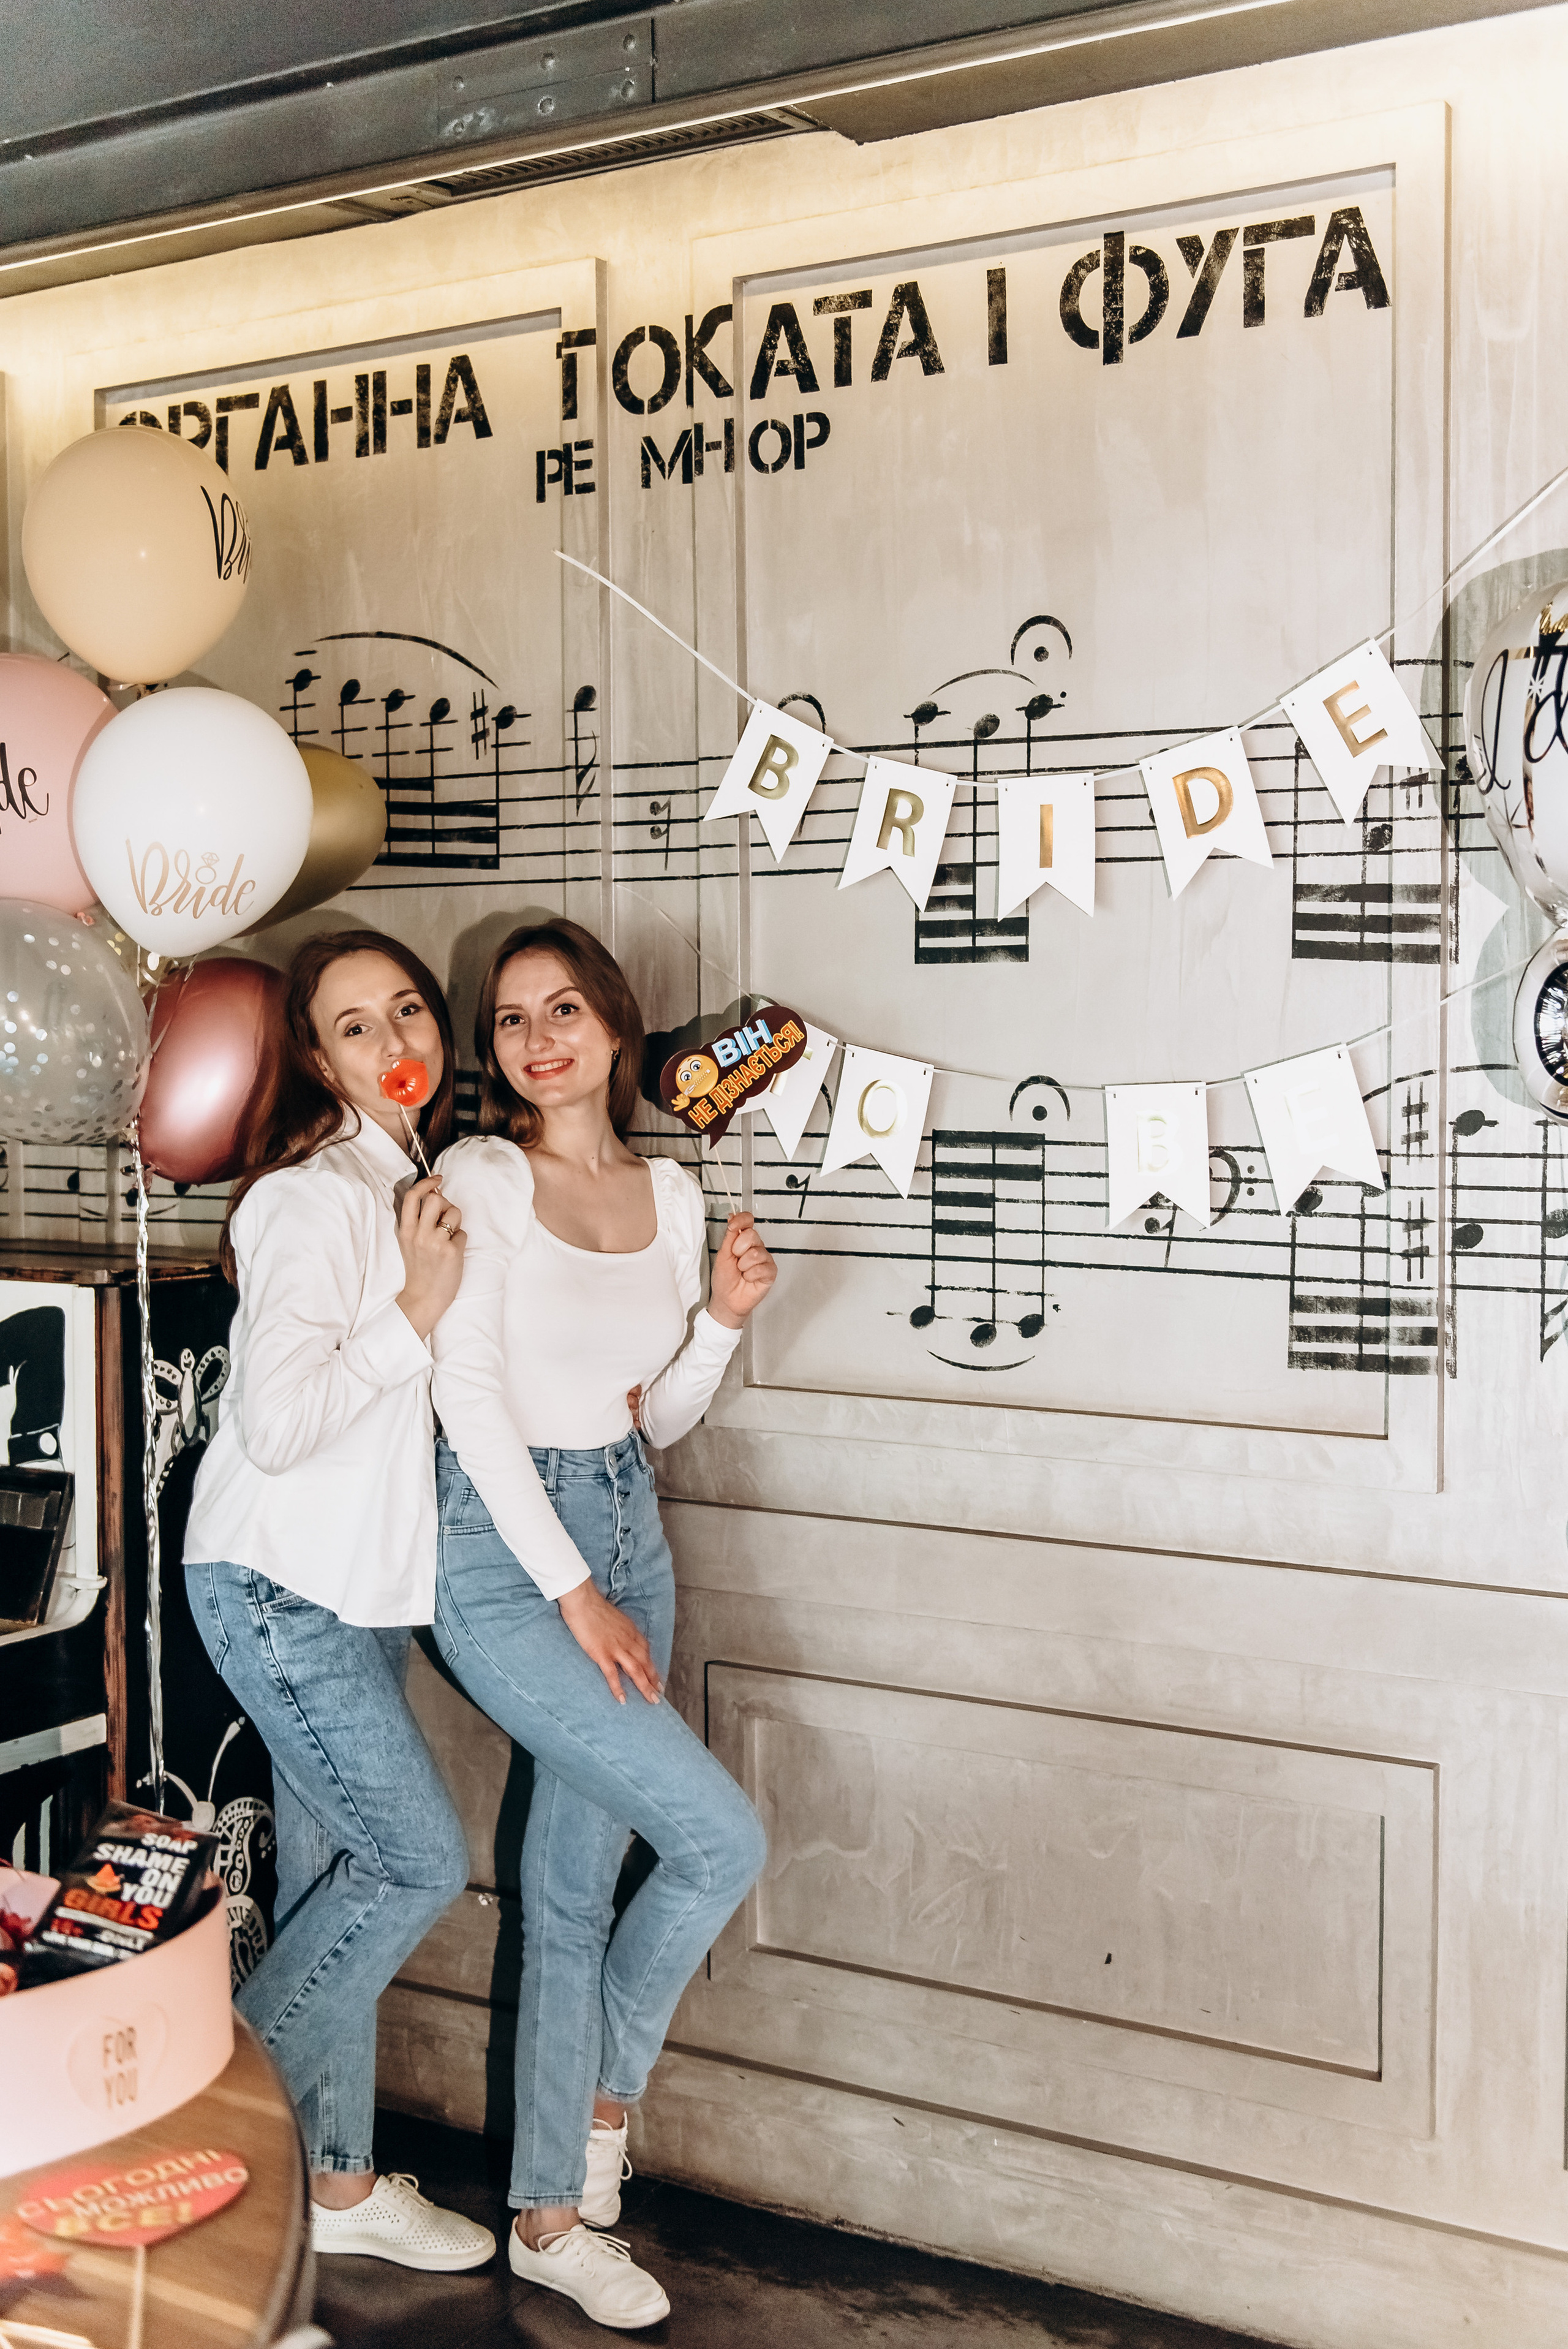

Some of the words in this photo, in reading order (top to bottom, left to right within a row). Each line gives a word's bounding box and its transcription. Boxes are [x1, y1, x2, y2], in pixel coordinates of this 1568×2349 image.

[119, 354, 493, 475] РГАННА
[556, 281, 945, 421] ТОКАТА
[987, 268, 1008, 366] І
[1060, 206, 1392, 366] ФУГА
[536, 439, 596, 503] РЕ
[747, 680, 1389, 869] BRIDE
[126, 838, 256, 919] Bride
[711, 1019, 772, 1067] ВІН
[688, 1097, 718, 1129] НЕ
[708, 1019, 805, 1114] ДІЗНАЄТЬСЯ!
[93, 1843, 190, 1876] SHAME
[141, 1833, 198, 1855] SOAP
[121, 1882, 174, 1908] YOU
[140, 1868, 182, 1893] ON
[103, 2026, 138, 2070] FOR
[72, 2166, 249, 2217] МОЖЛИВО
